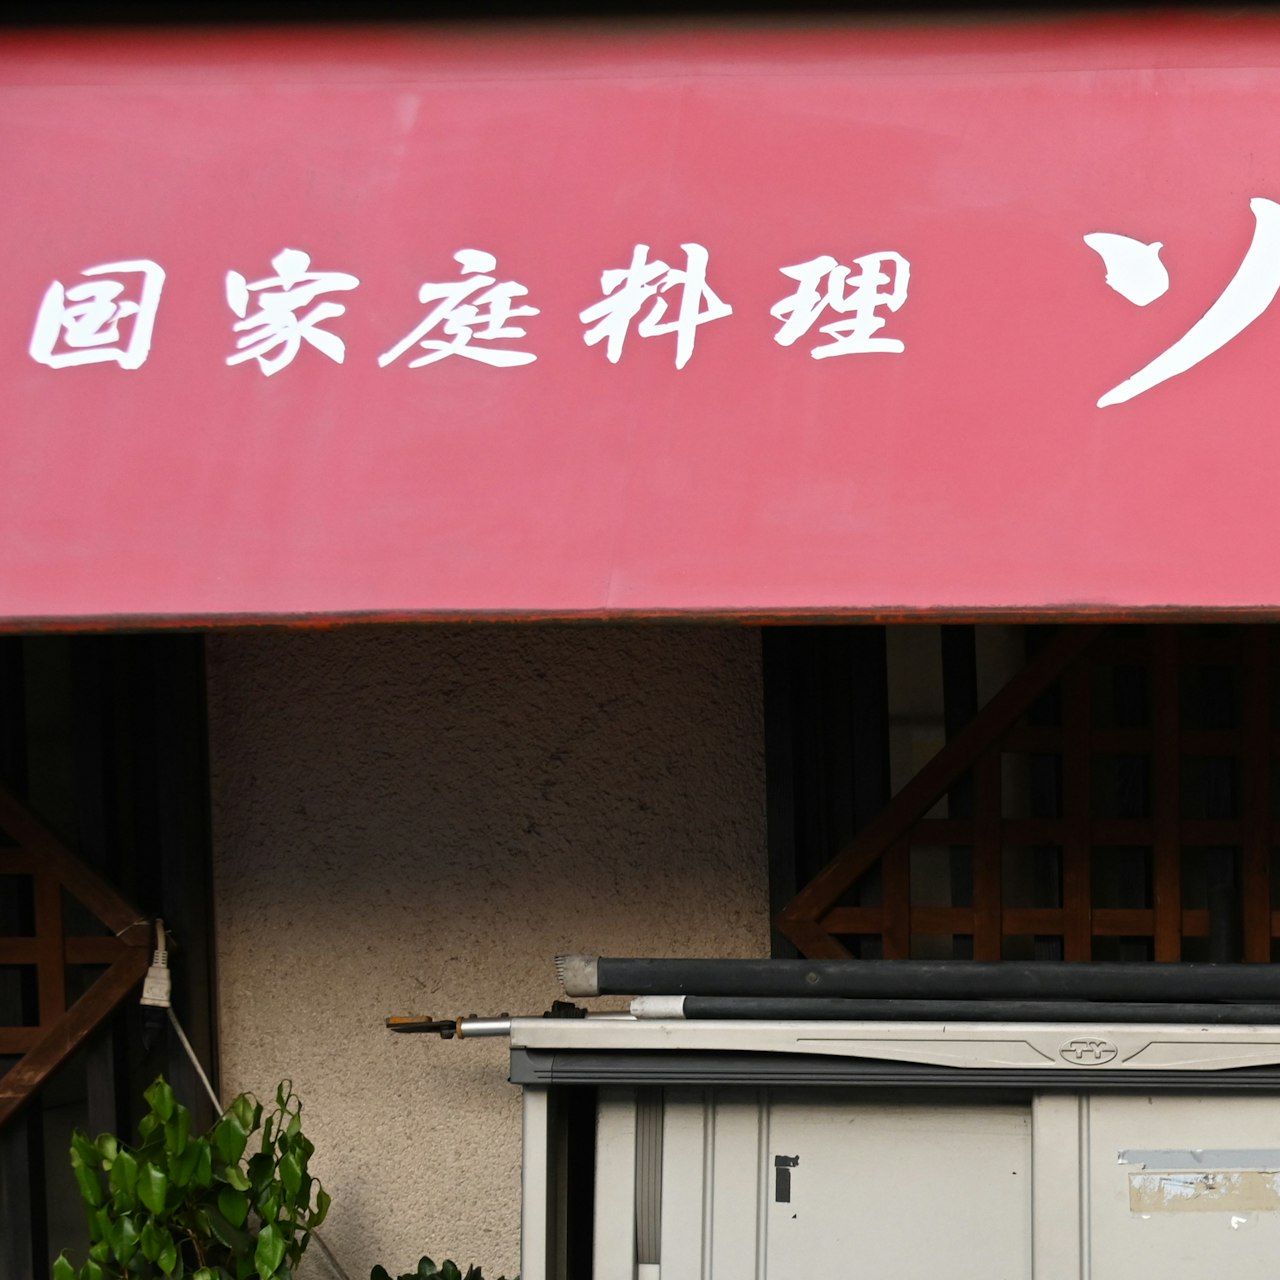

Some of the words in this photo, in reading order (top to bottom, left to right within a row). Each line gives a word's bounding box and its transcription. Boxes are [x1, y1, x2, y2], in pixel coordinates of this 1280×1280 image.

[28, 242, 911, 377] 国家庭料理
